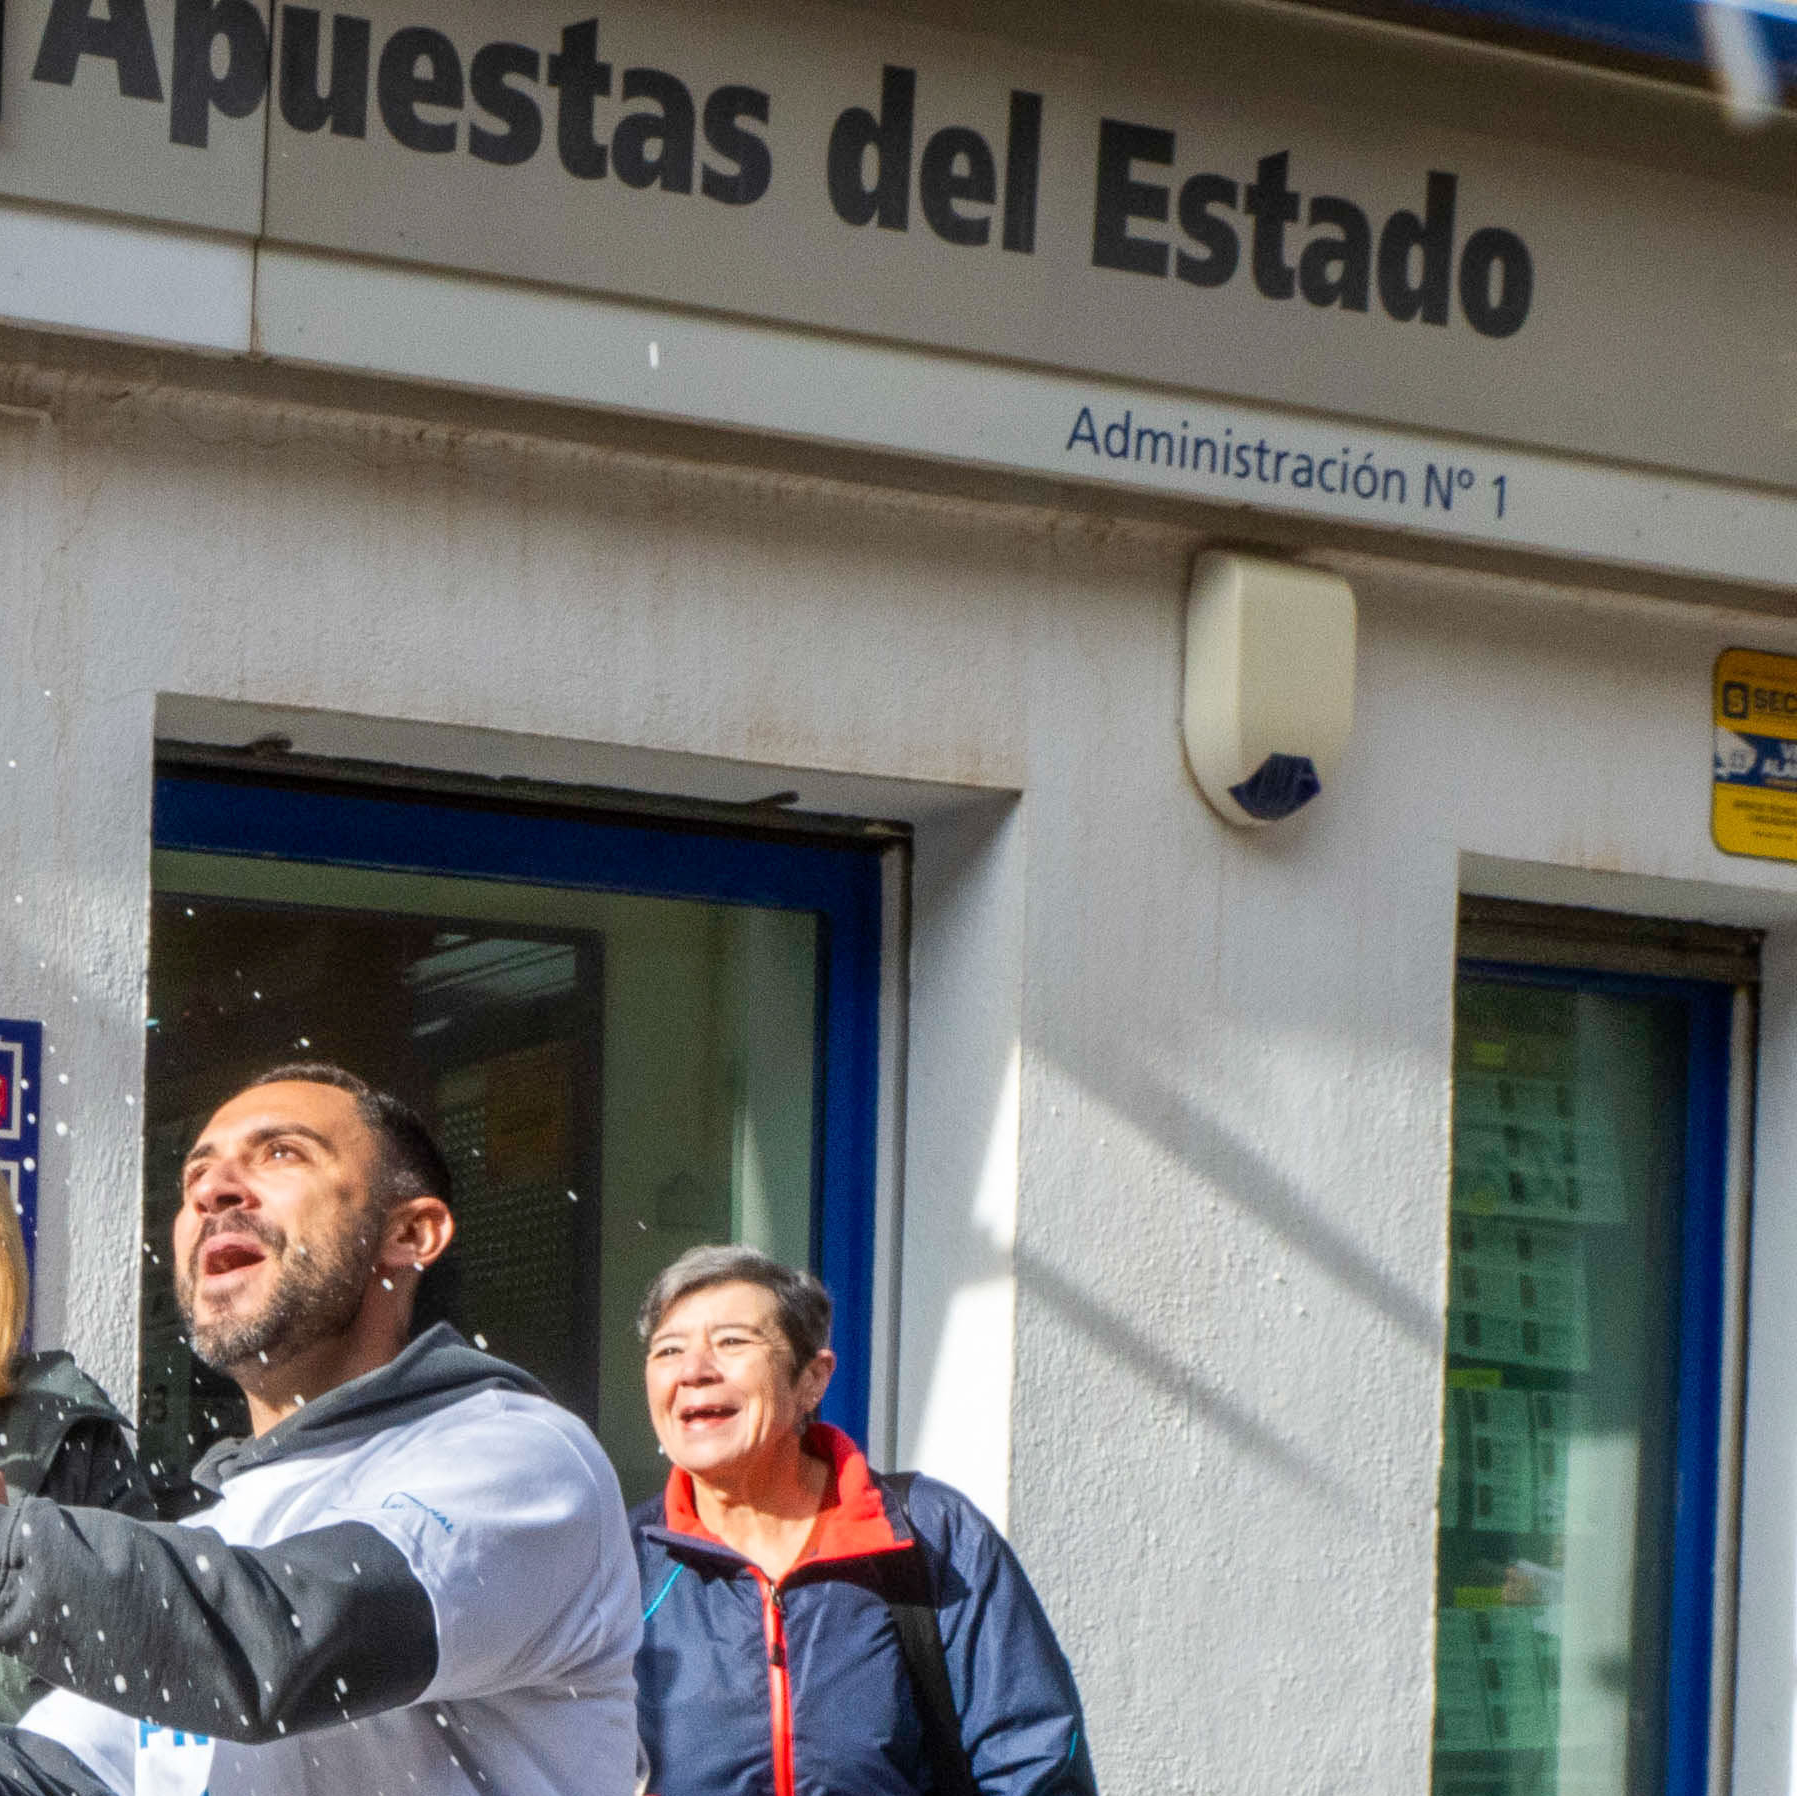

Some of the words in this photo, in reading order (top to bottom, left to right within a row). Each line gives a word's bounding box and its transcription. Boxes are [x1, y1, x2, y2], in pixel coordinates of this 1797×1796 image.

[33, 0, 772, 205] Apuestas
[826, 64, 1043, 255] del
[1090, 116, 1536, 340] Estado
[1065, 405, 1407, 504] Administración
[1423, 462, 1475, 512] Nº
[1492, 474, 1508, 519] 1
